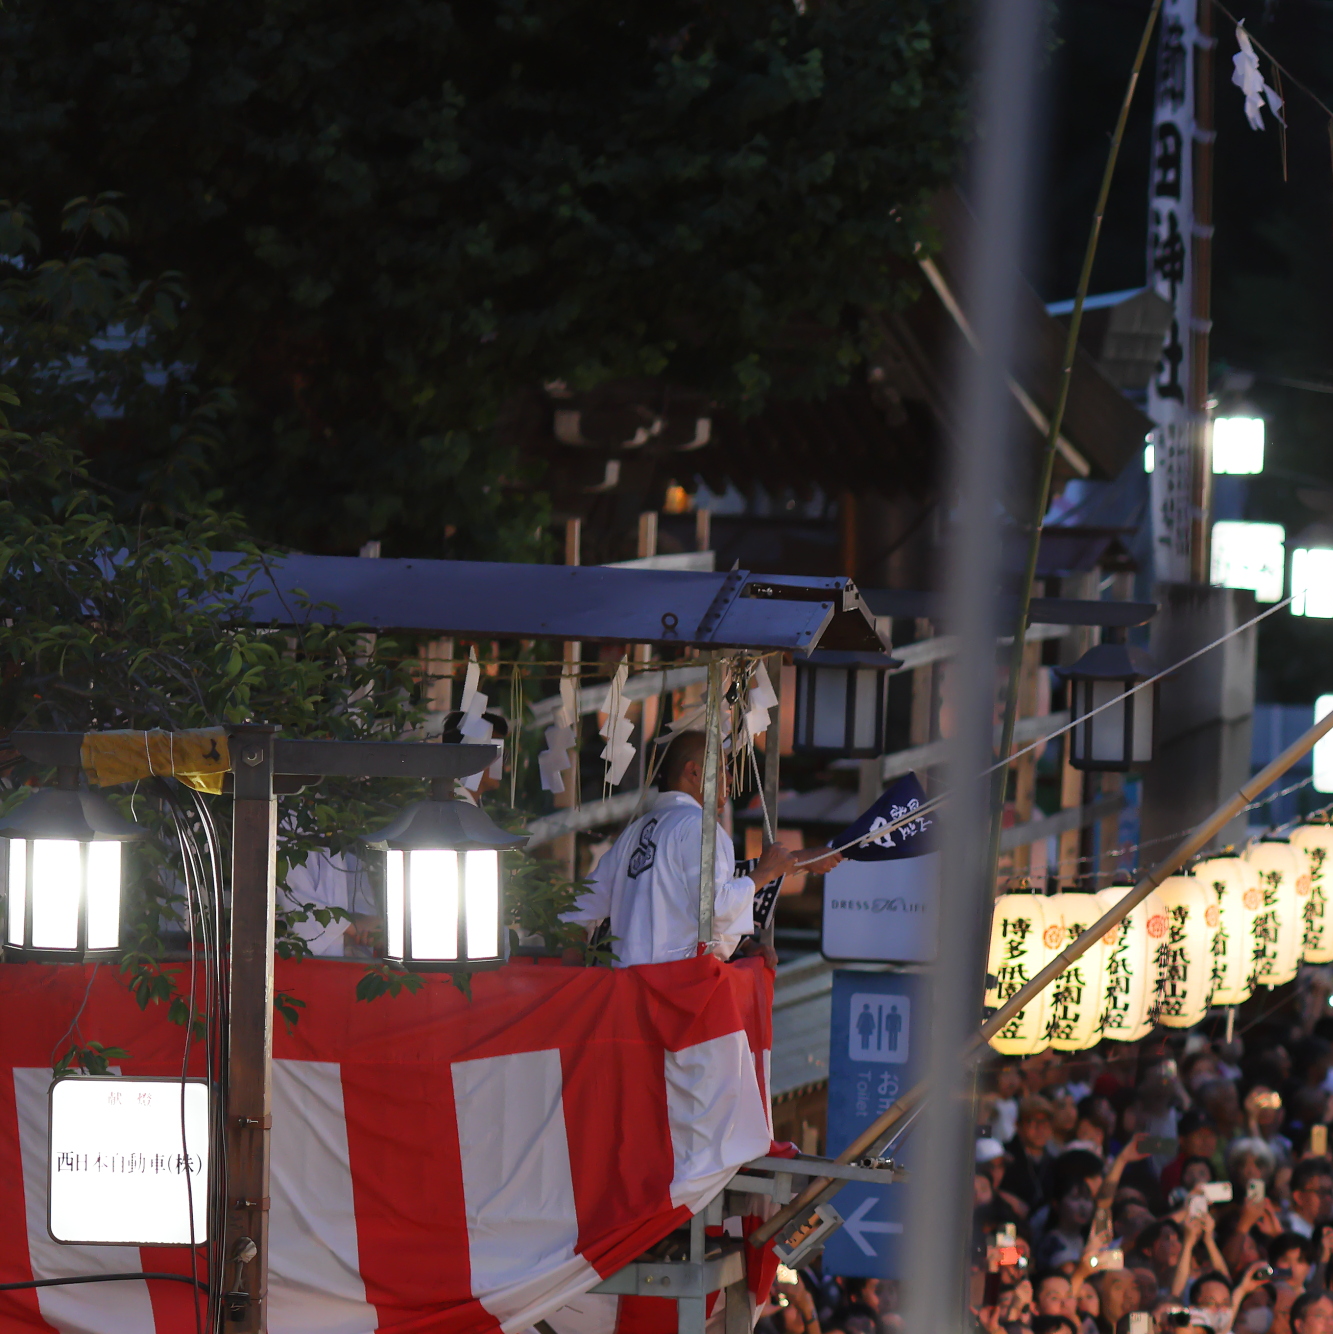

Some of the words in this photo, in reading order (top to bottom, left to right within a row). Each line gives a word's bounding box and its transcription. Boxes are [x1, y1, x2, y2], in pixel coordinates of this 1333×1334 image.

[831, 899, 870, 910] DRESS
[856, 1070, 872, 1118] Toilet
[57, 1150, 203, 1176] 西日本自動車(株)
